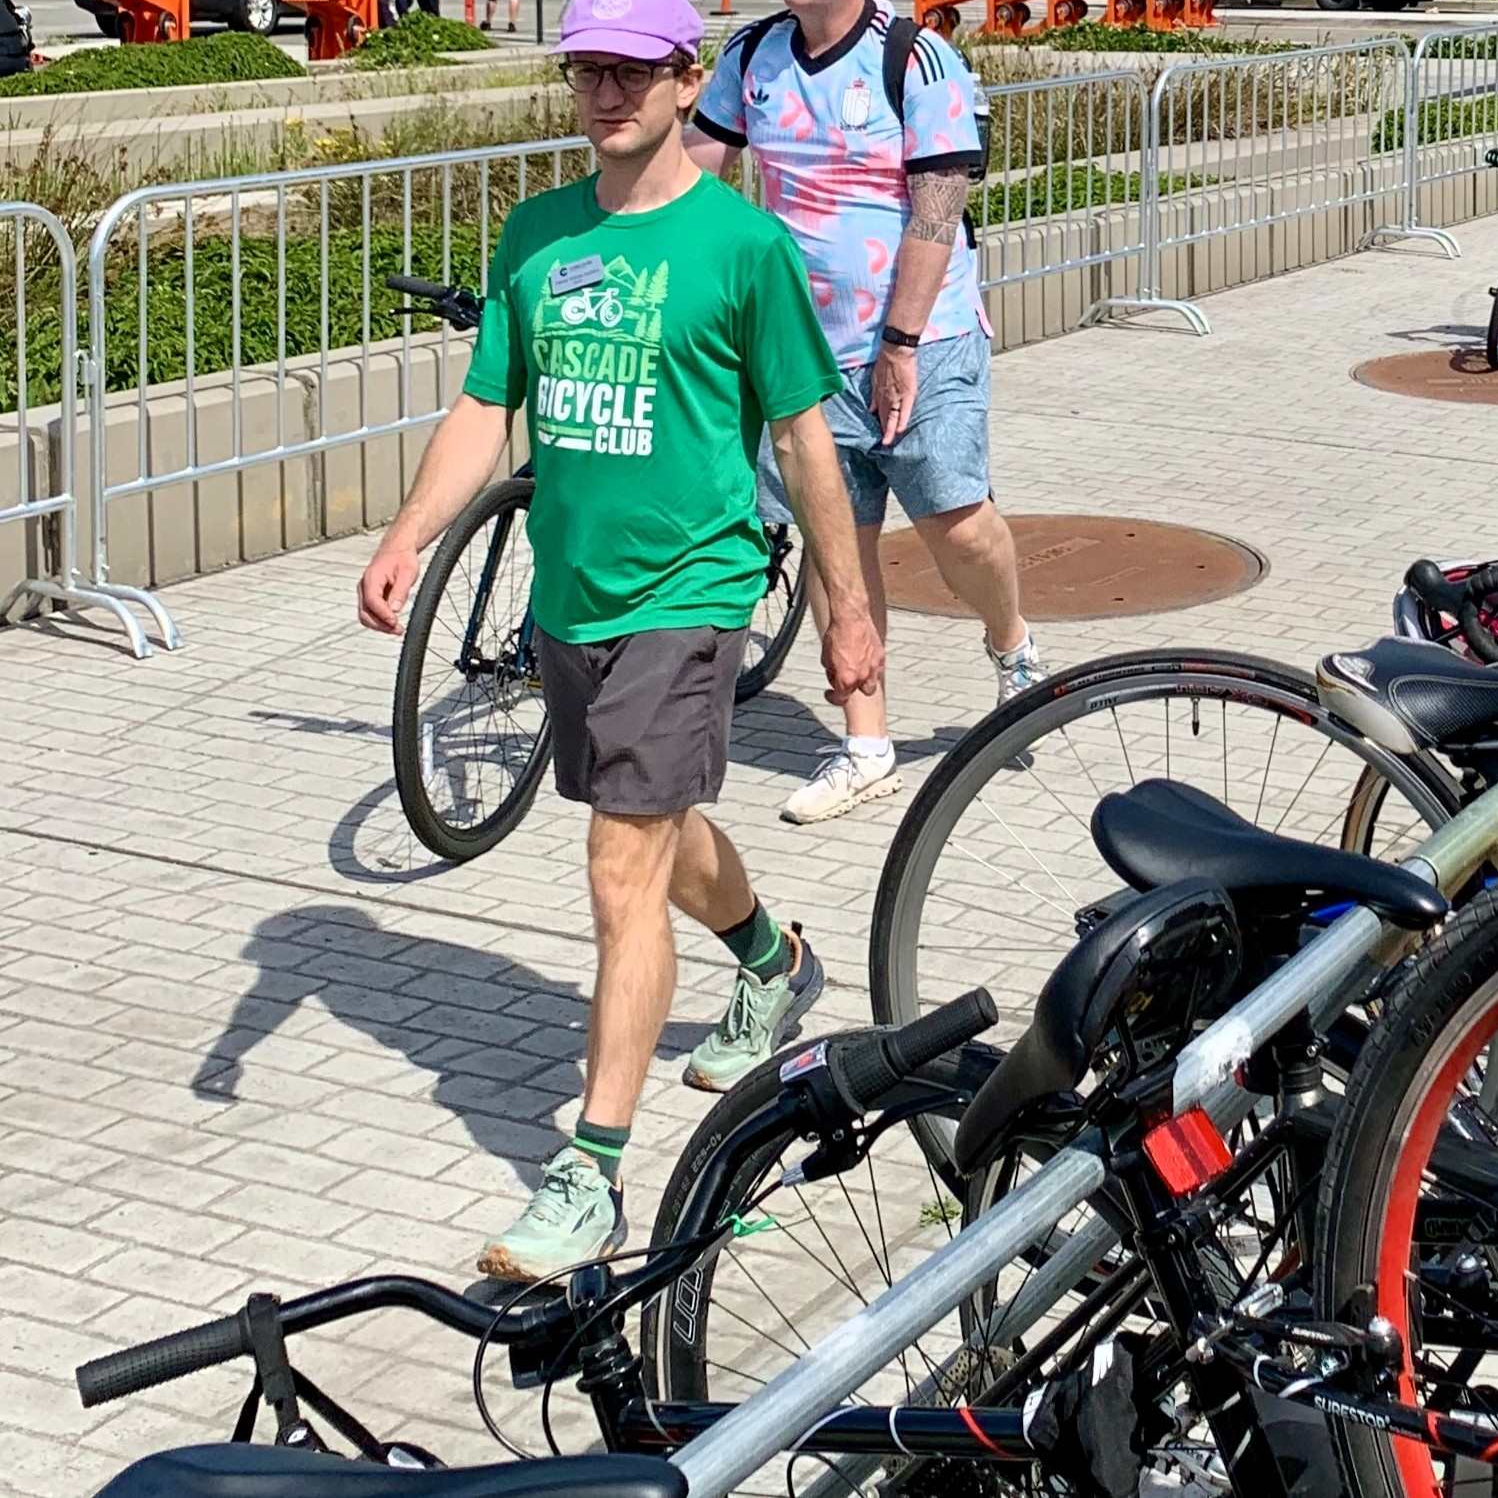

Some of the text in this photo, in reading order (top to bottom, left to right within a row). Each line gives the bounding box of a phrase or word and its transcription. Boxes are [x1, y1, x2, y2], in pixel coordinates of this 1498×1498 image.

[532, 339, 660, 385] CASCADE
[537, 374, 657, 429] BICYCLE
[594, 426, 653, 456] CLUB
